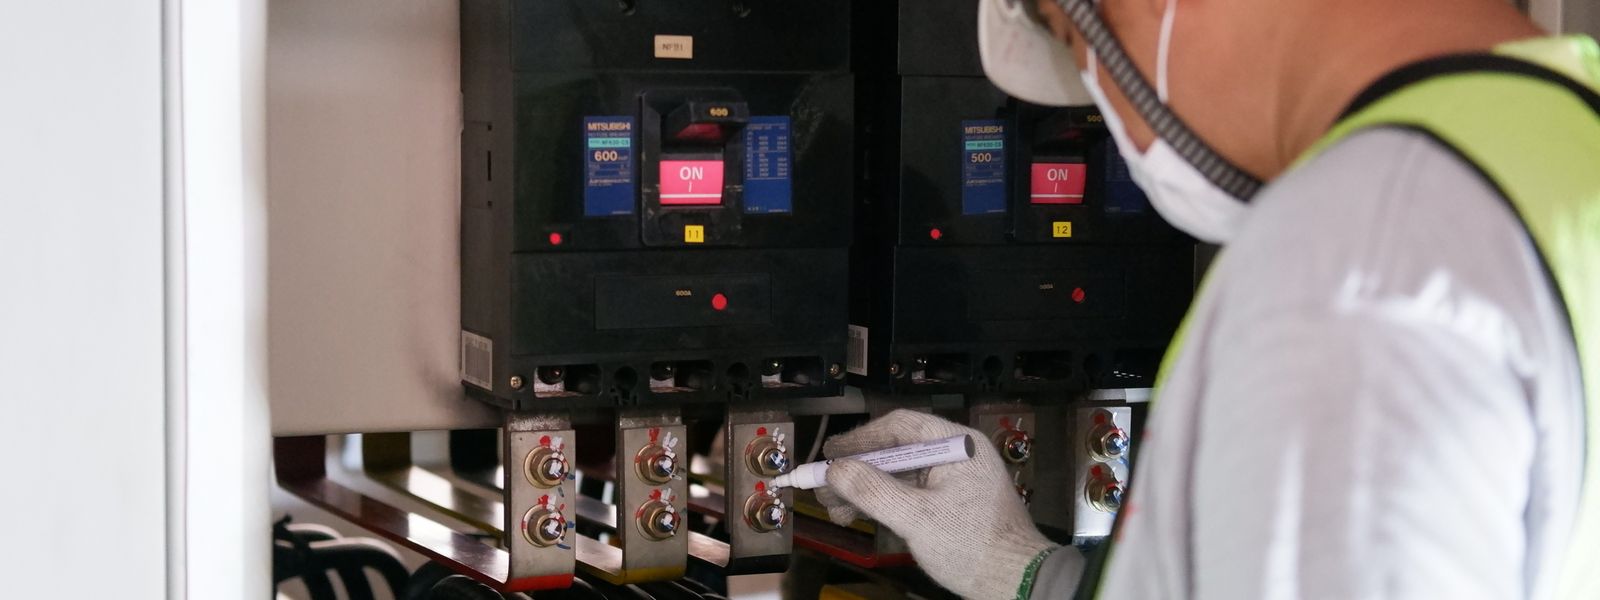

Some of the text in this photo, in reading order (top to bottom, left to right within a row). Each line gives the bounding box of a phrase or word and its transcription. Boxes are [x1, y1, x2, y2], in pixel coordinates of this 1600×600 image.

[710, 107, 728, 116] 600
[587, 122, 631, 131] MITSUBISHI
[964, 125, 1003, 134] MITSUBISHI
[594, 150, 617, 162] 600
[971, 152, 992, 163] 500
[680, 166, 703, 180] ON
[1047, 168, 1068, 181] ON
[688, 230, 699, 238] 11
[1056, 225, 1068, 235] 12
